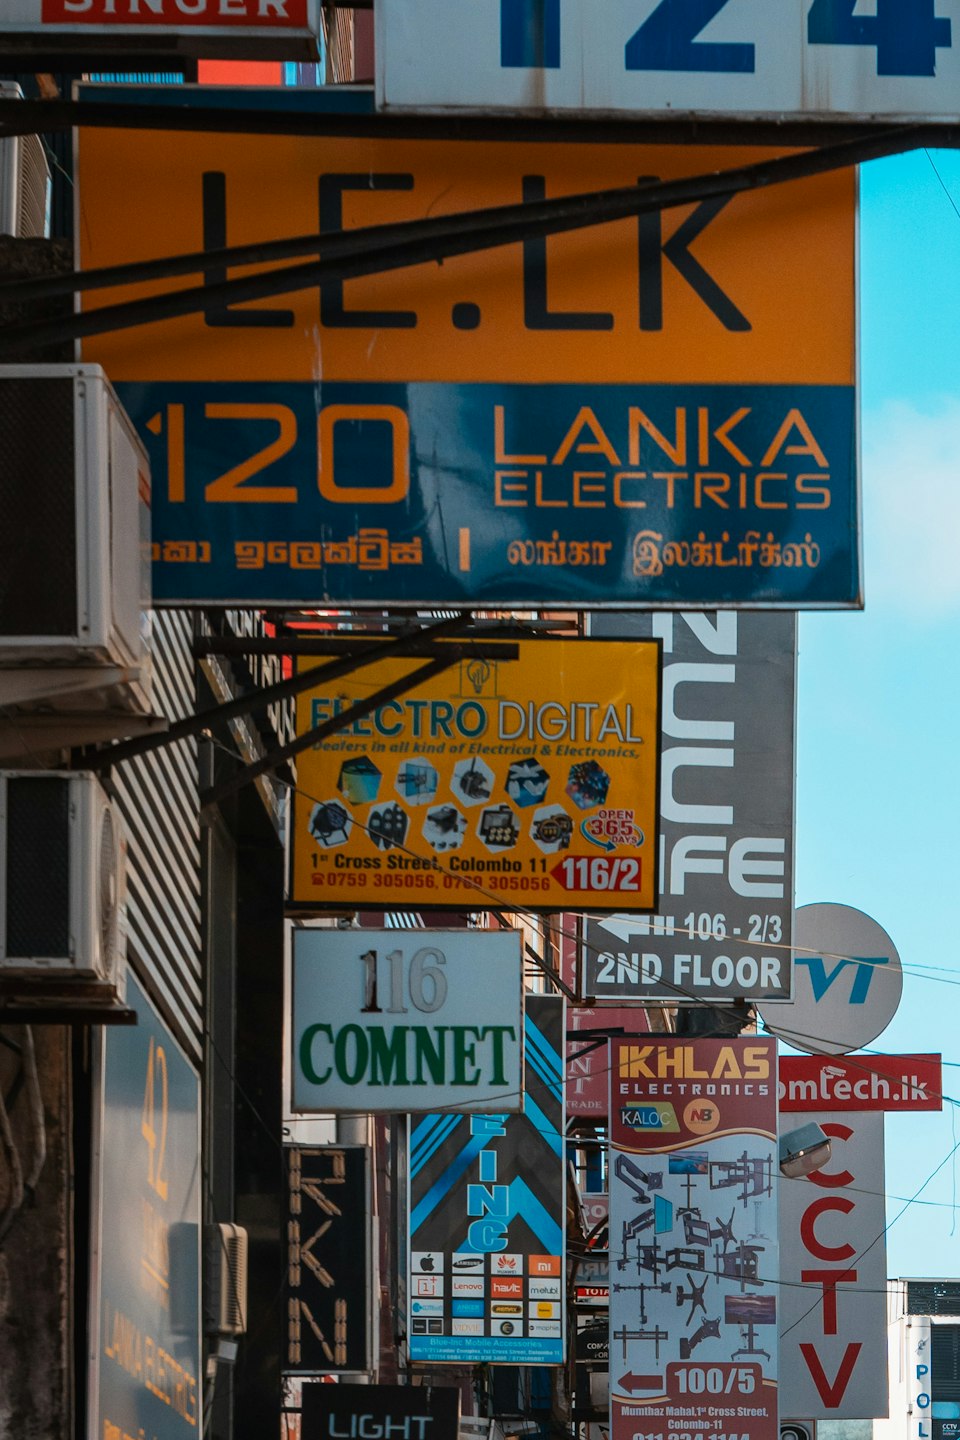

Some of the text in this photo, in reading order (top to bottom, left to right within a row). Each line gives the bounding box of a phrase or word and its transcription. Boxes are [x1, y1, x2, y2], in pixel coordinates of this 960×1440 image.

[201, 171, 753, 332] LE.LK
[146, 403, 410, 505] 120
[494, 406, 831, 468] LANKA
[494, 471, 832, 510] ELECTRICS
[507, 530, 612, 566] லங்கா
[311, 697, 644, 744] ELECTRO DIGITAL
[590, 819, 634, 837] 365
[599, 810, 634, 821] OPEN
[611, 835, 638, 845] DAYS
[334, 854, 381, 870] Cross
[387, 854, 443, 873] Street,
[449, 856, 522, 873] Colombo
[528, 857, 547, 873] 11
[561, 857, 640, 892] 116/2
[683, 912, 783, 944] 106 2/3
[360, 947, 448, 1014] 116
[596, 952, 782, 989] 2ND FLOOR
[299, 1022, 517, 1087] COMNET
[619, 1046, 771, 1080] IKHLAS
[619, 1083, 770, 1096] ELECTRONICS
[620, 1110, 671, 1126] KALOC
[674, 1368, 756, 1395] 100/5
[327, 1413, 435, 1440] LIGHT
[667, 1419, 723, 1430] Colombo-11
